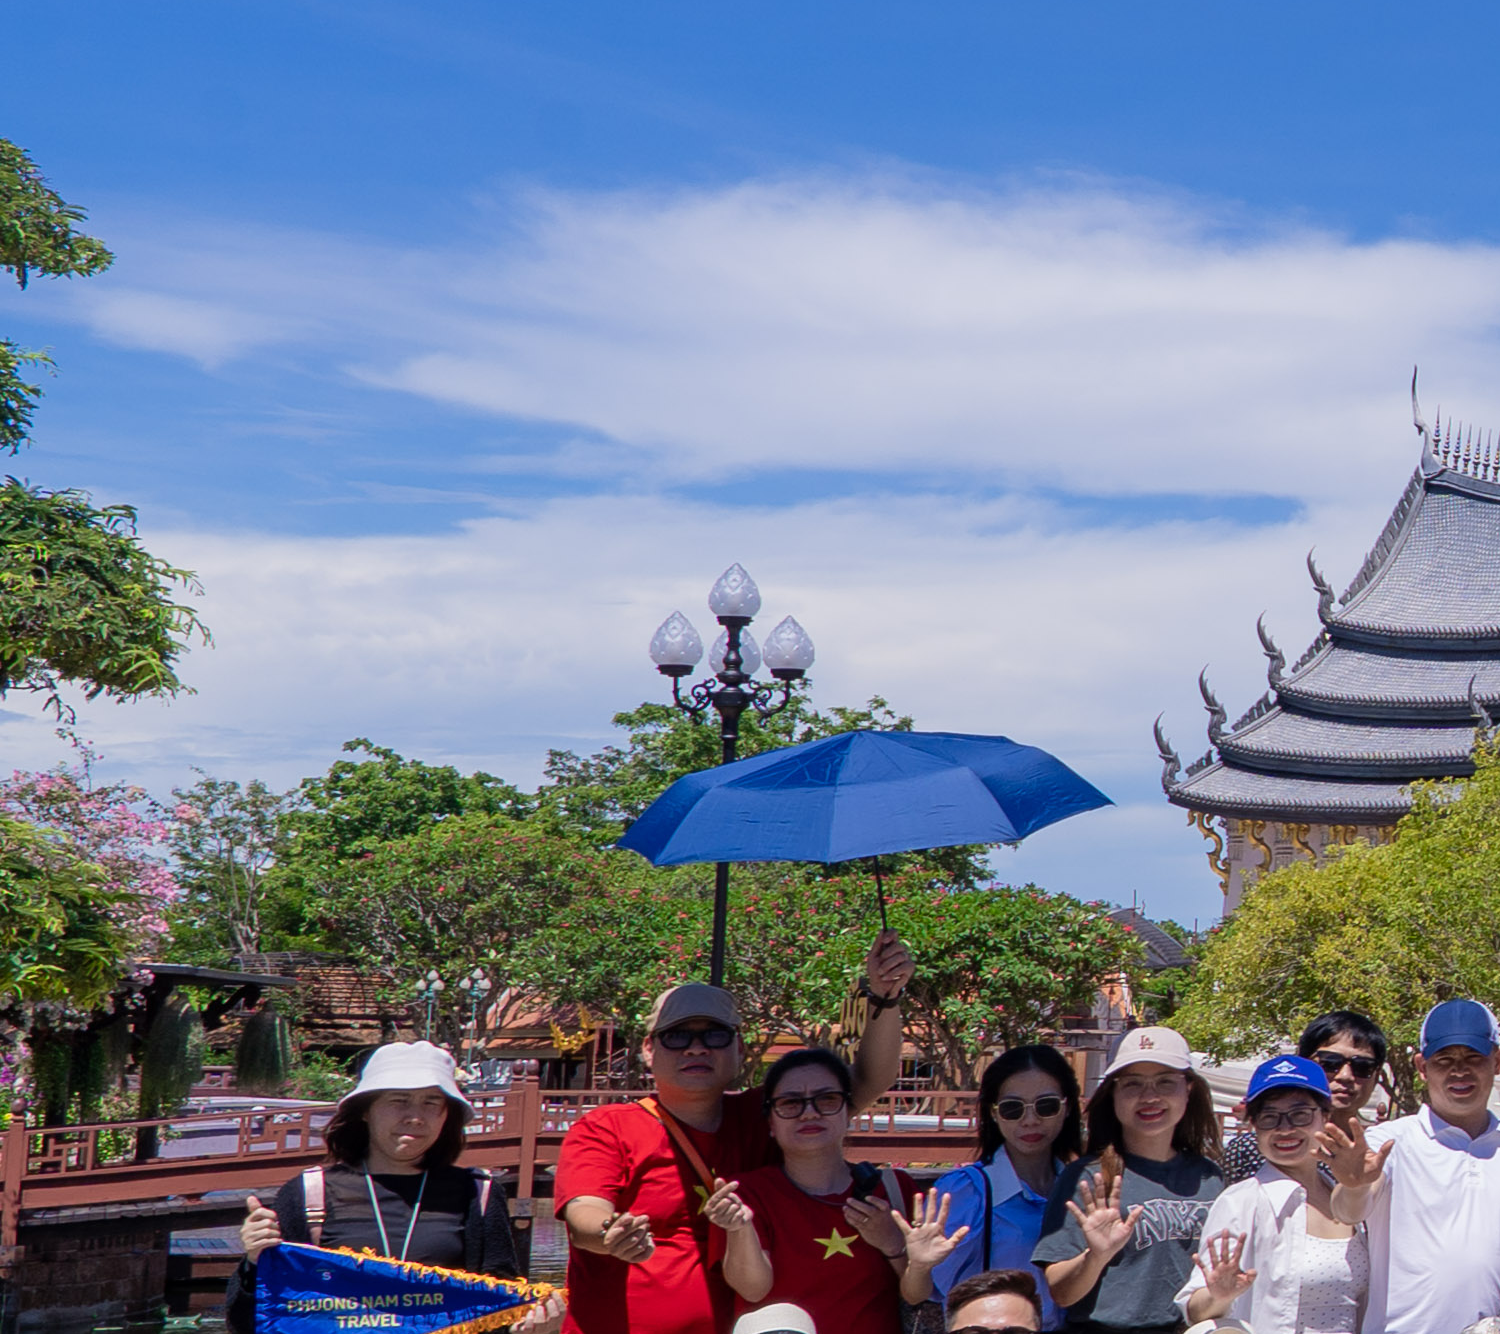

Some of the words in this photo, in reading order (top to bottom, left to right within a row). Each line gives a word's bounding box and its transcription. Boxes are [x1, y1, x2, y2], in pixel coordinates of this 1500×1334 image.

[287, 1297, 358, 1312] PHUONG
[361, 1293, 399, 1309] NAM
[402, 1292, 444, 1307] STAR
[336, 1313, 401, 1329] TRAVEL
